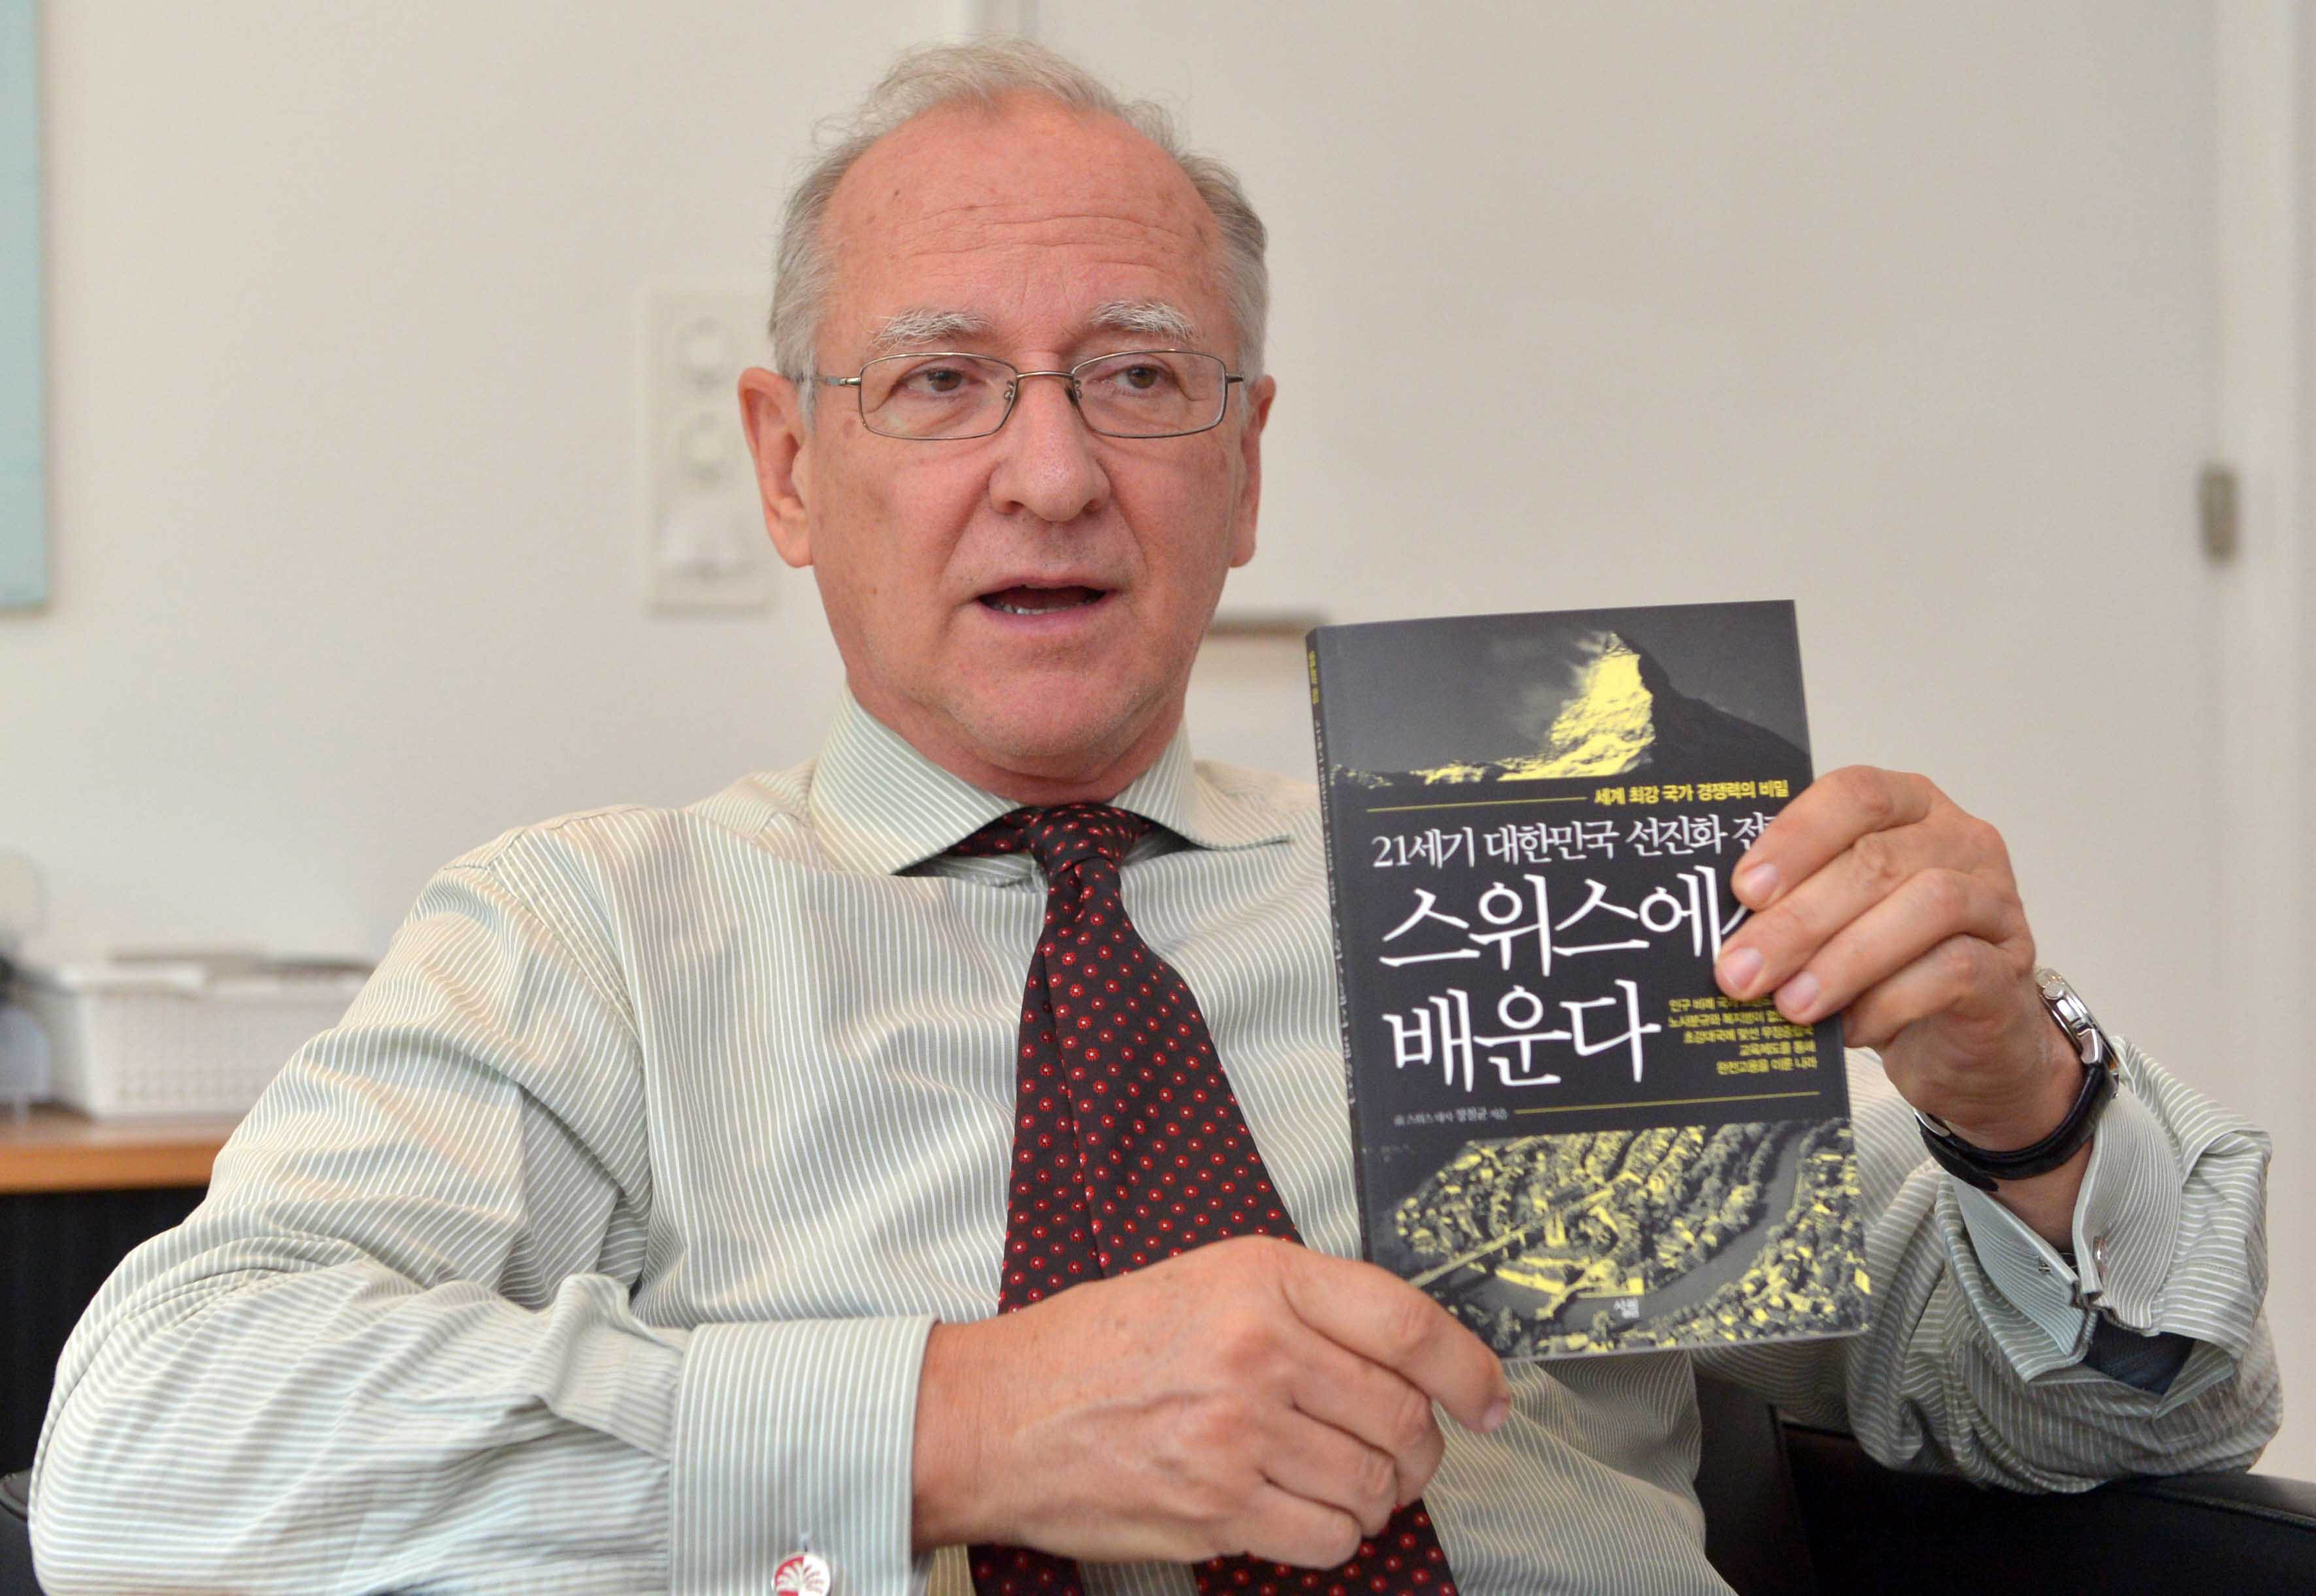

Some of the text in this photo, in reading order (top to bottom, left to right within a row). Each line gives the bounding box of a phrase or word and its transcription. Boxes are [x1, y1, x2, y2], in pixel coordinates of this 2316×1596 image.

[1595, 780, 1789, 805] 세계 최강 국가 경쟁력의 비밀
[1372, 811, 1776, 869] 21세기 대한민국 선진화 전
[1380, 865, 1748, 976] 스위스에
[1381, 978, 1662, 1092] 배운다
